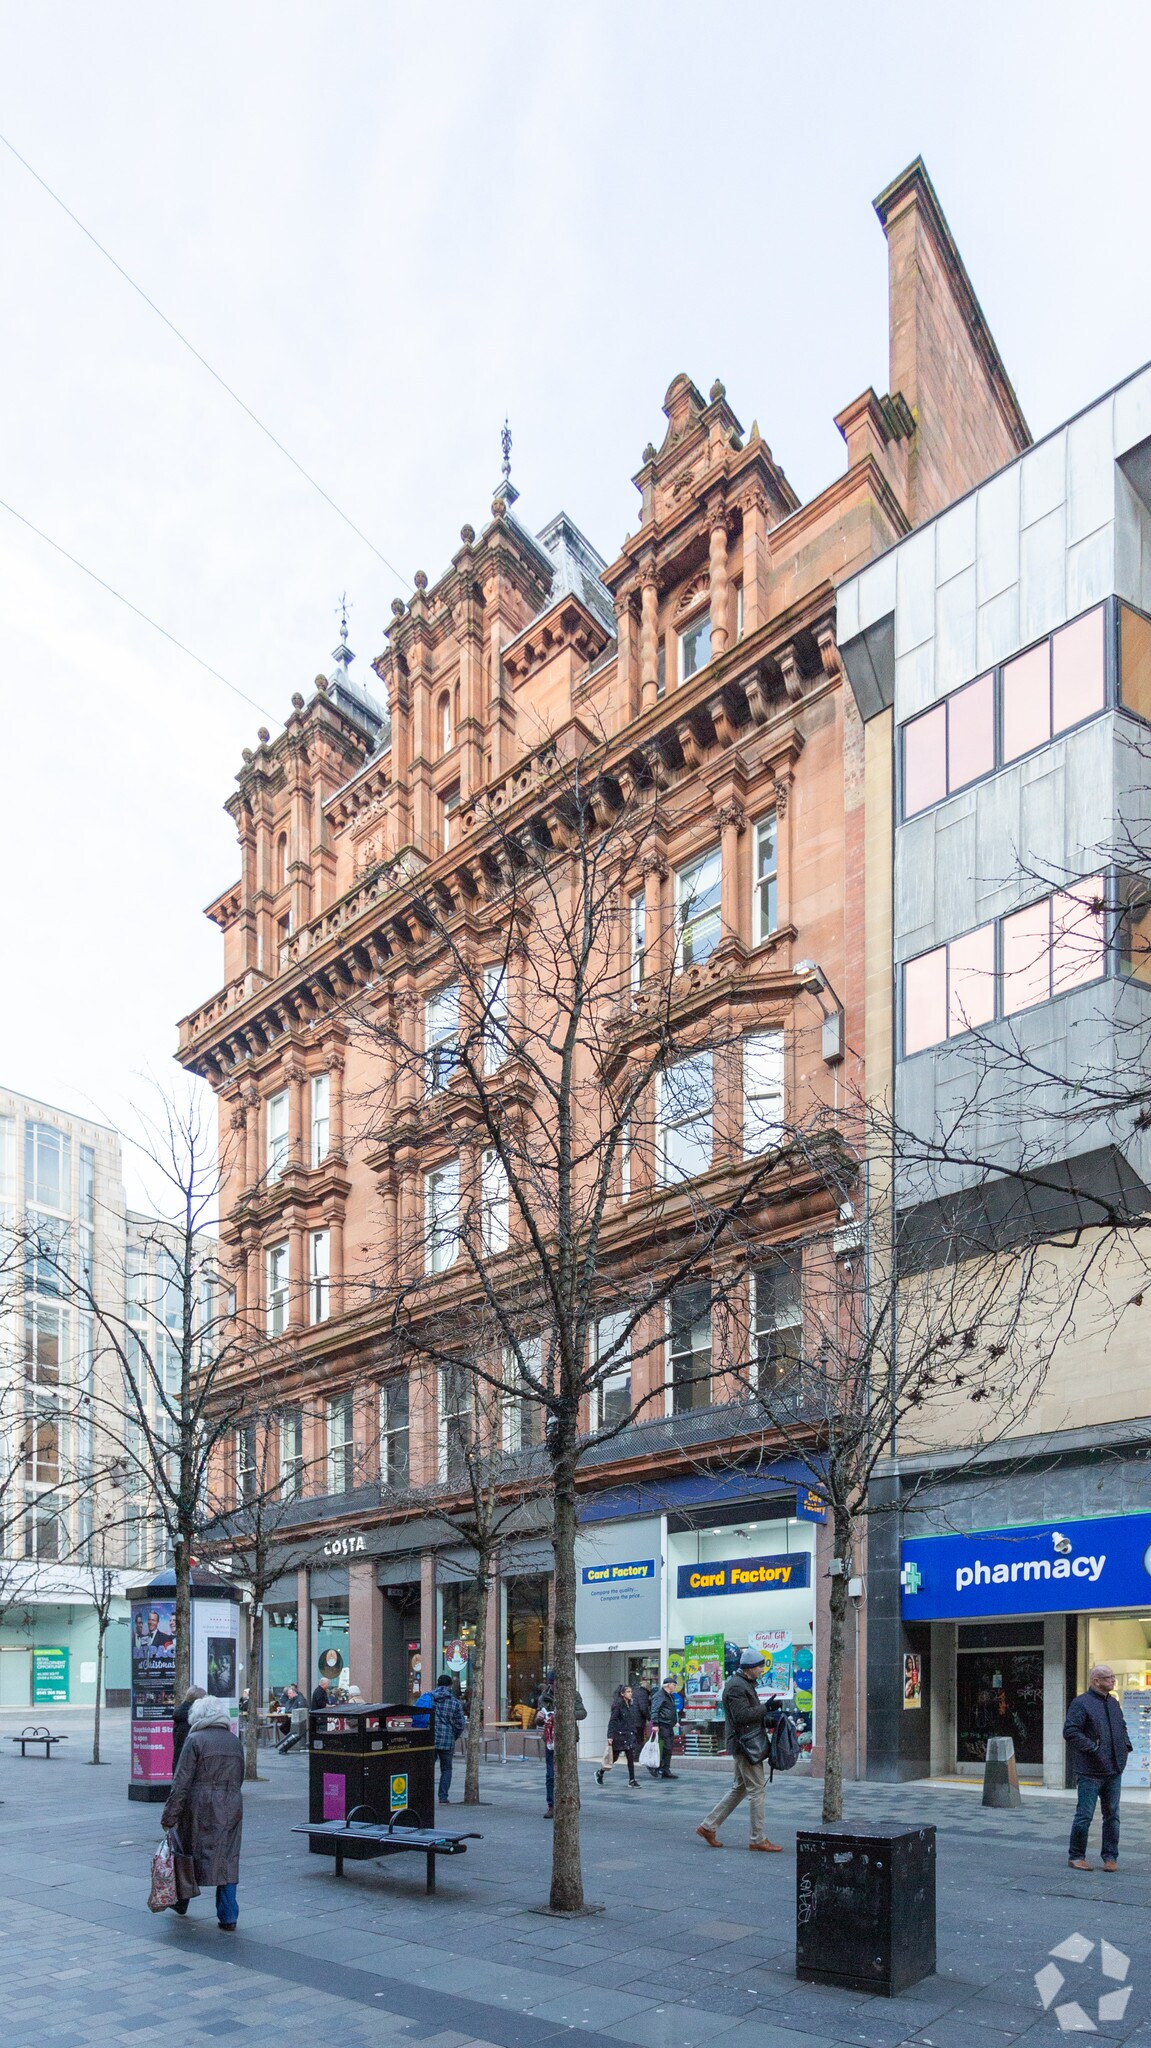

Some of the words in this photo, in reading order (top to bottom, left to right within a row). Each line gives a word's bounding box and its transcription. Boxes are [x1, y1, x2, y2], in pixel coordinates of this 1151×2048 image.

[323, 1535, 367, 1556] COSTA
[587, 1568, 610, 1581] Card
[612, 1565, 648, 1577] Factory
[690, 1571, 725, 1588] Card
[731, 1566, 792, 1585] Factory
[956, 1554, 1106, 1591] pharmacy
[755, 1632, 772, 1641] Giant
[774, 1631, 786, 1641] Gift
[762, 1641, 779, 1650] Bags
